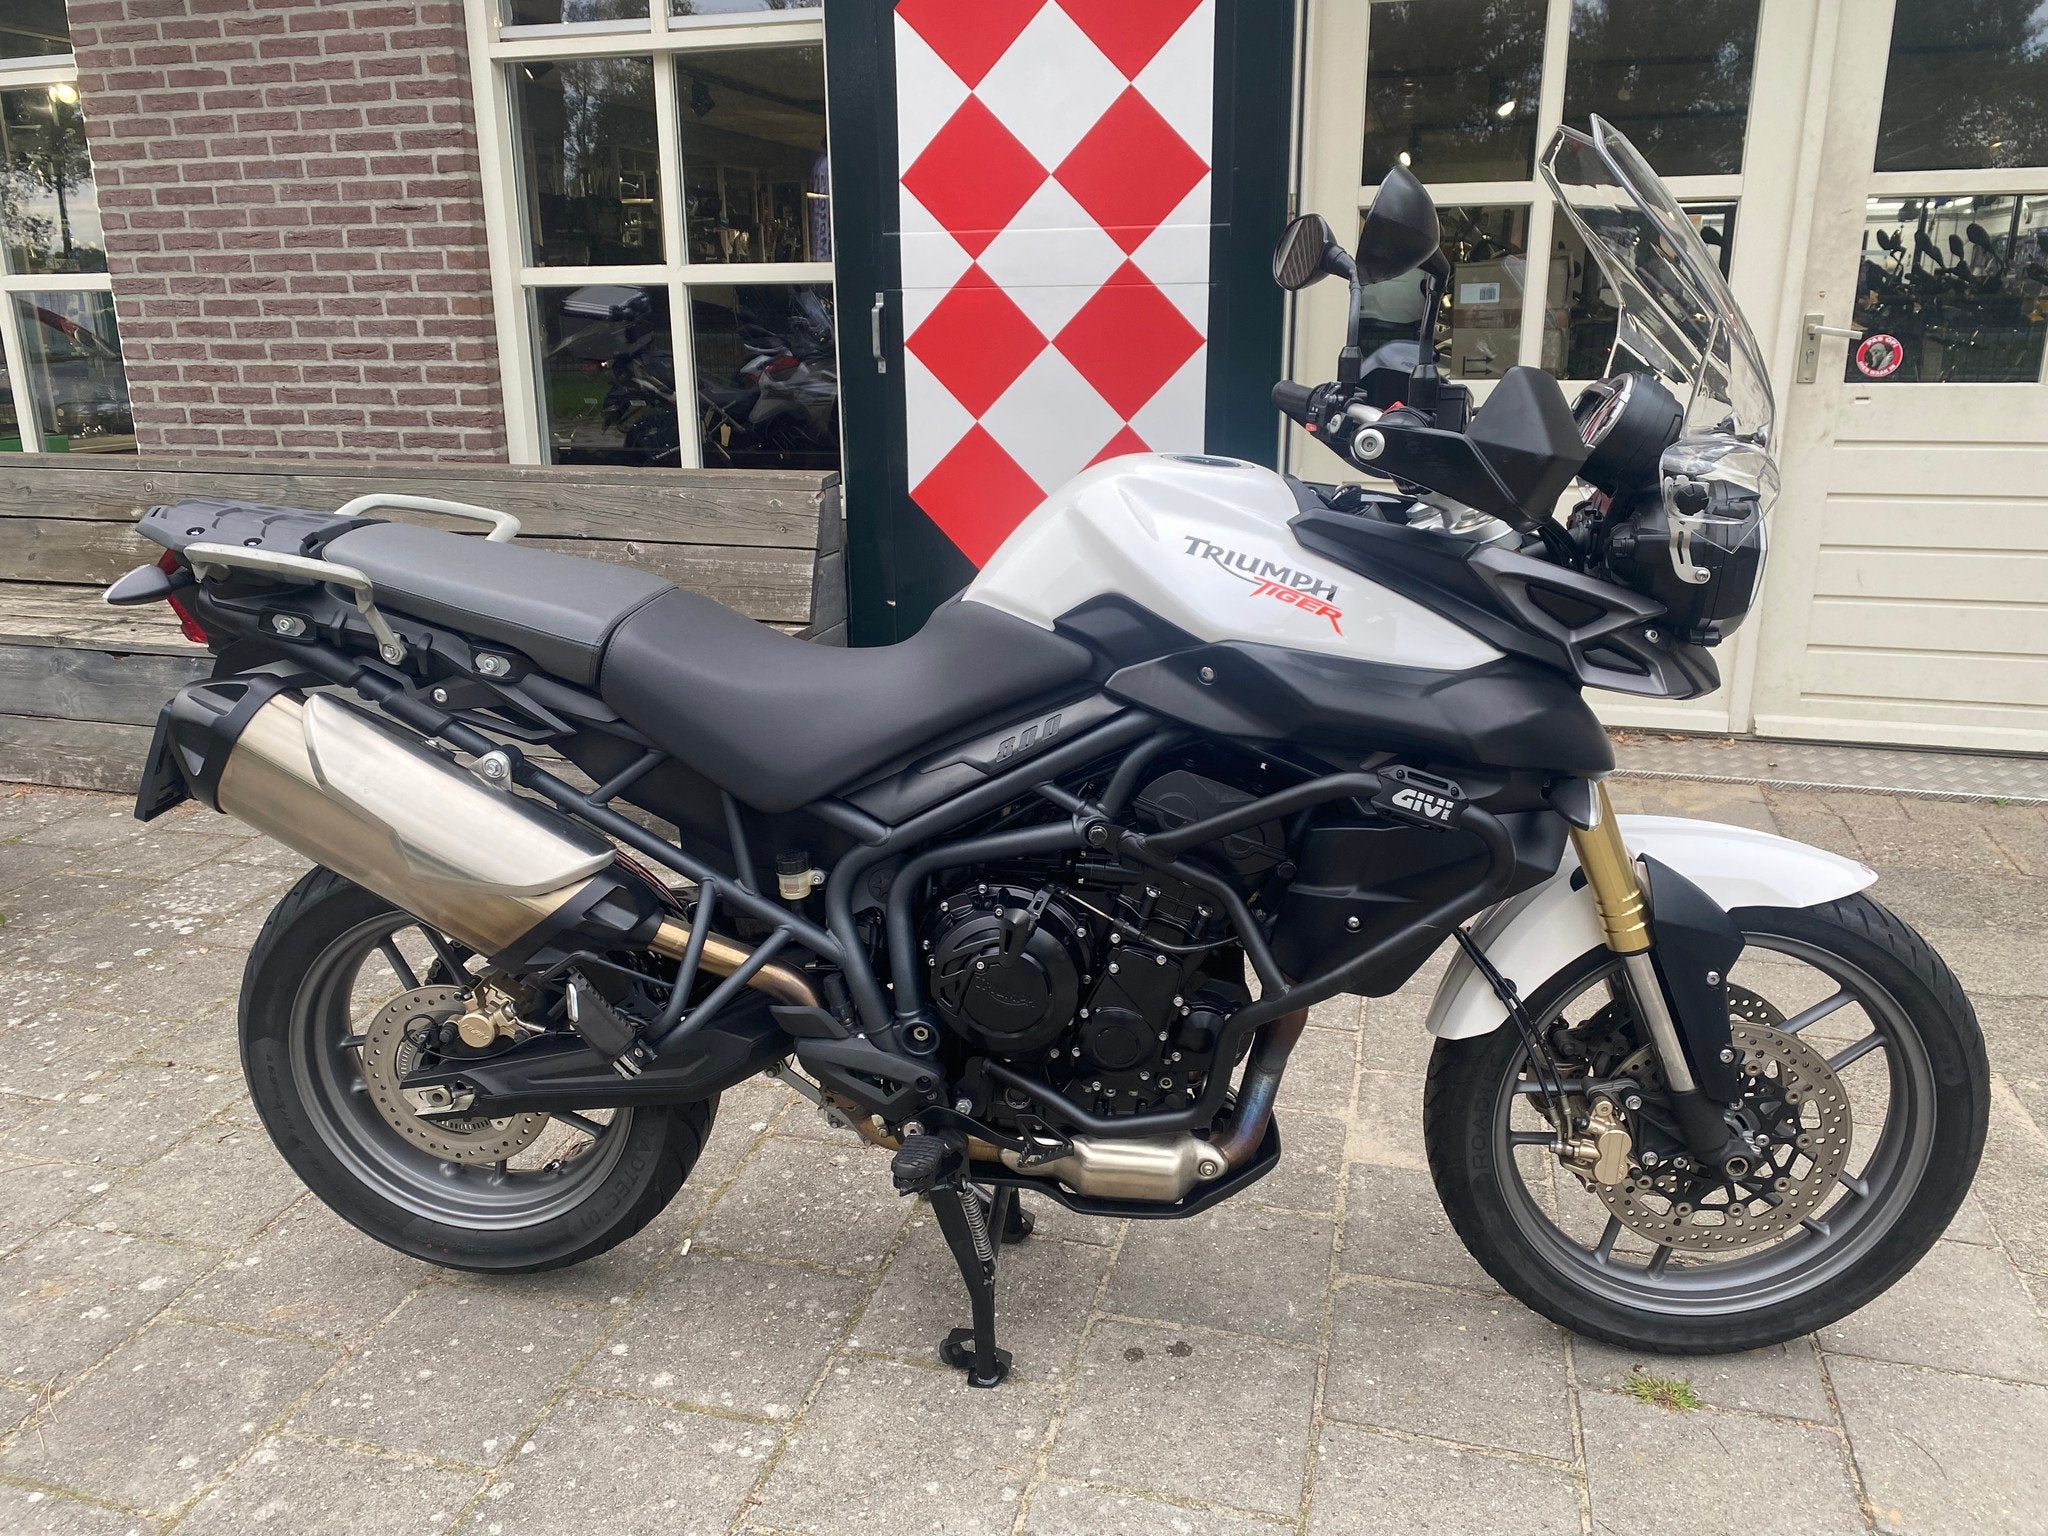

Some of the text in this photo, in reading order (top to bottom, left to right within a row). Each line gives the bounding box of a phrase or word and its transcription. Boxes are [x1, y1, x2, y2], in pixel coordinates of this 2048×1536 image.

[1184, 535, 1338, 603] TRIUMPH
[1249, 576, 1344, 637] TIGER
[993, 713, 1063, 763] 800
[1391, 788, 1455, 821] GIVI
